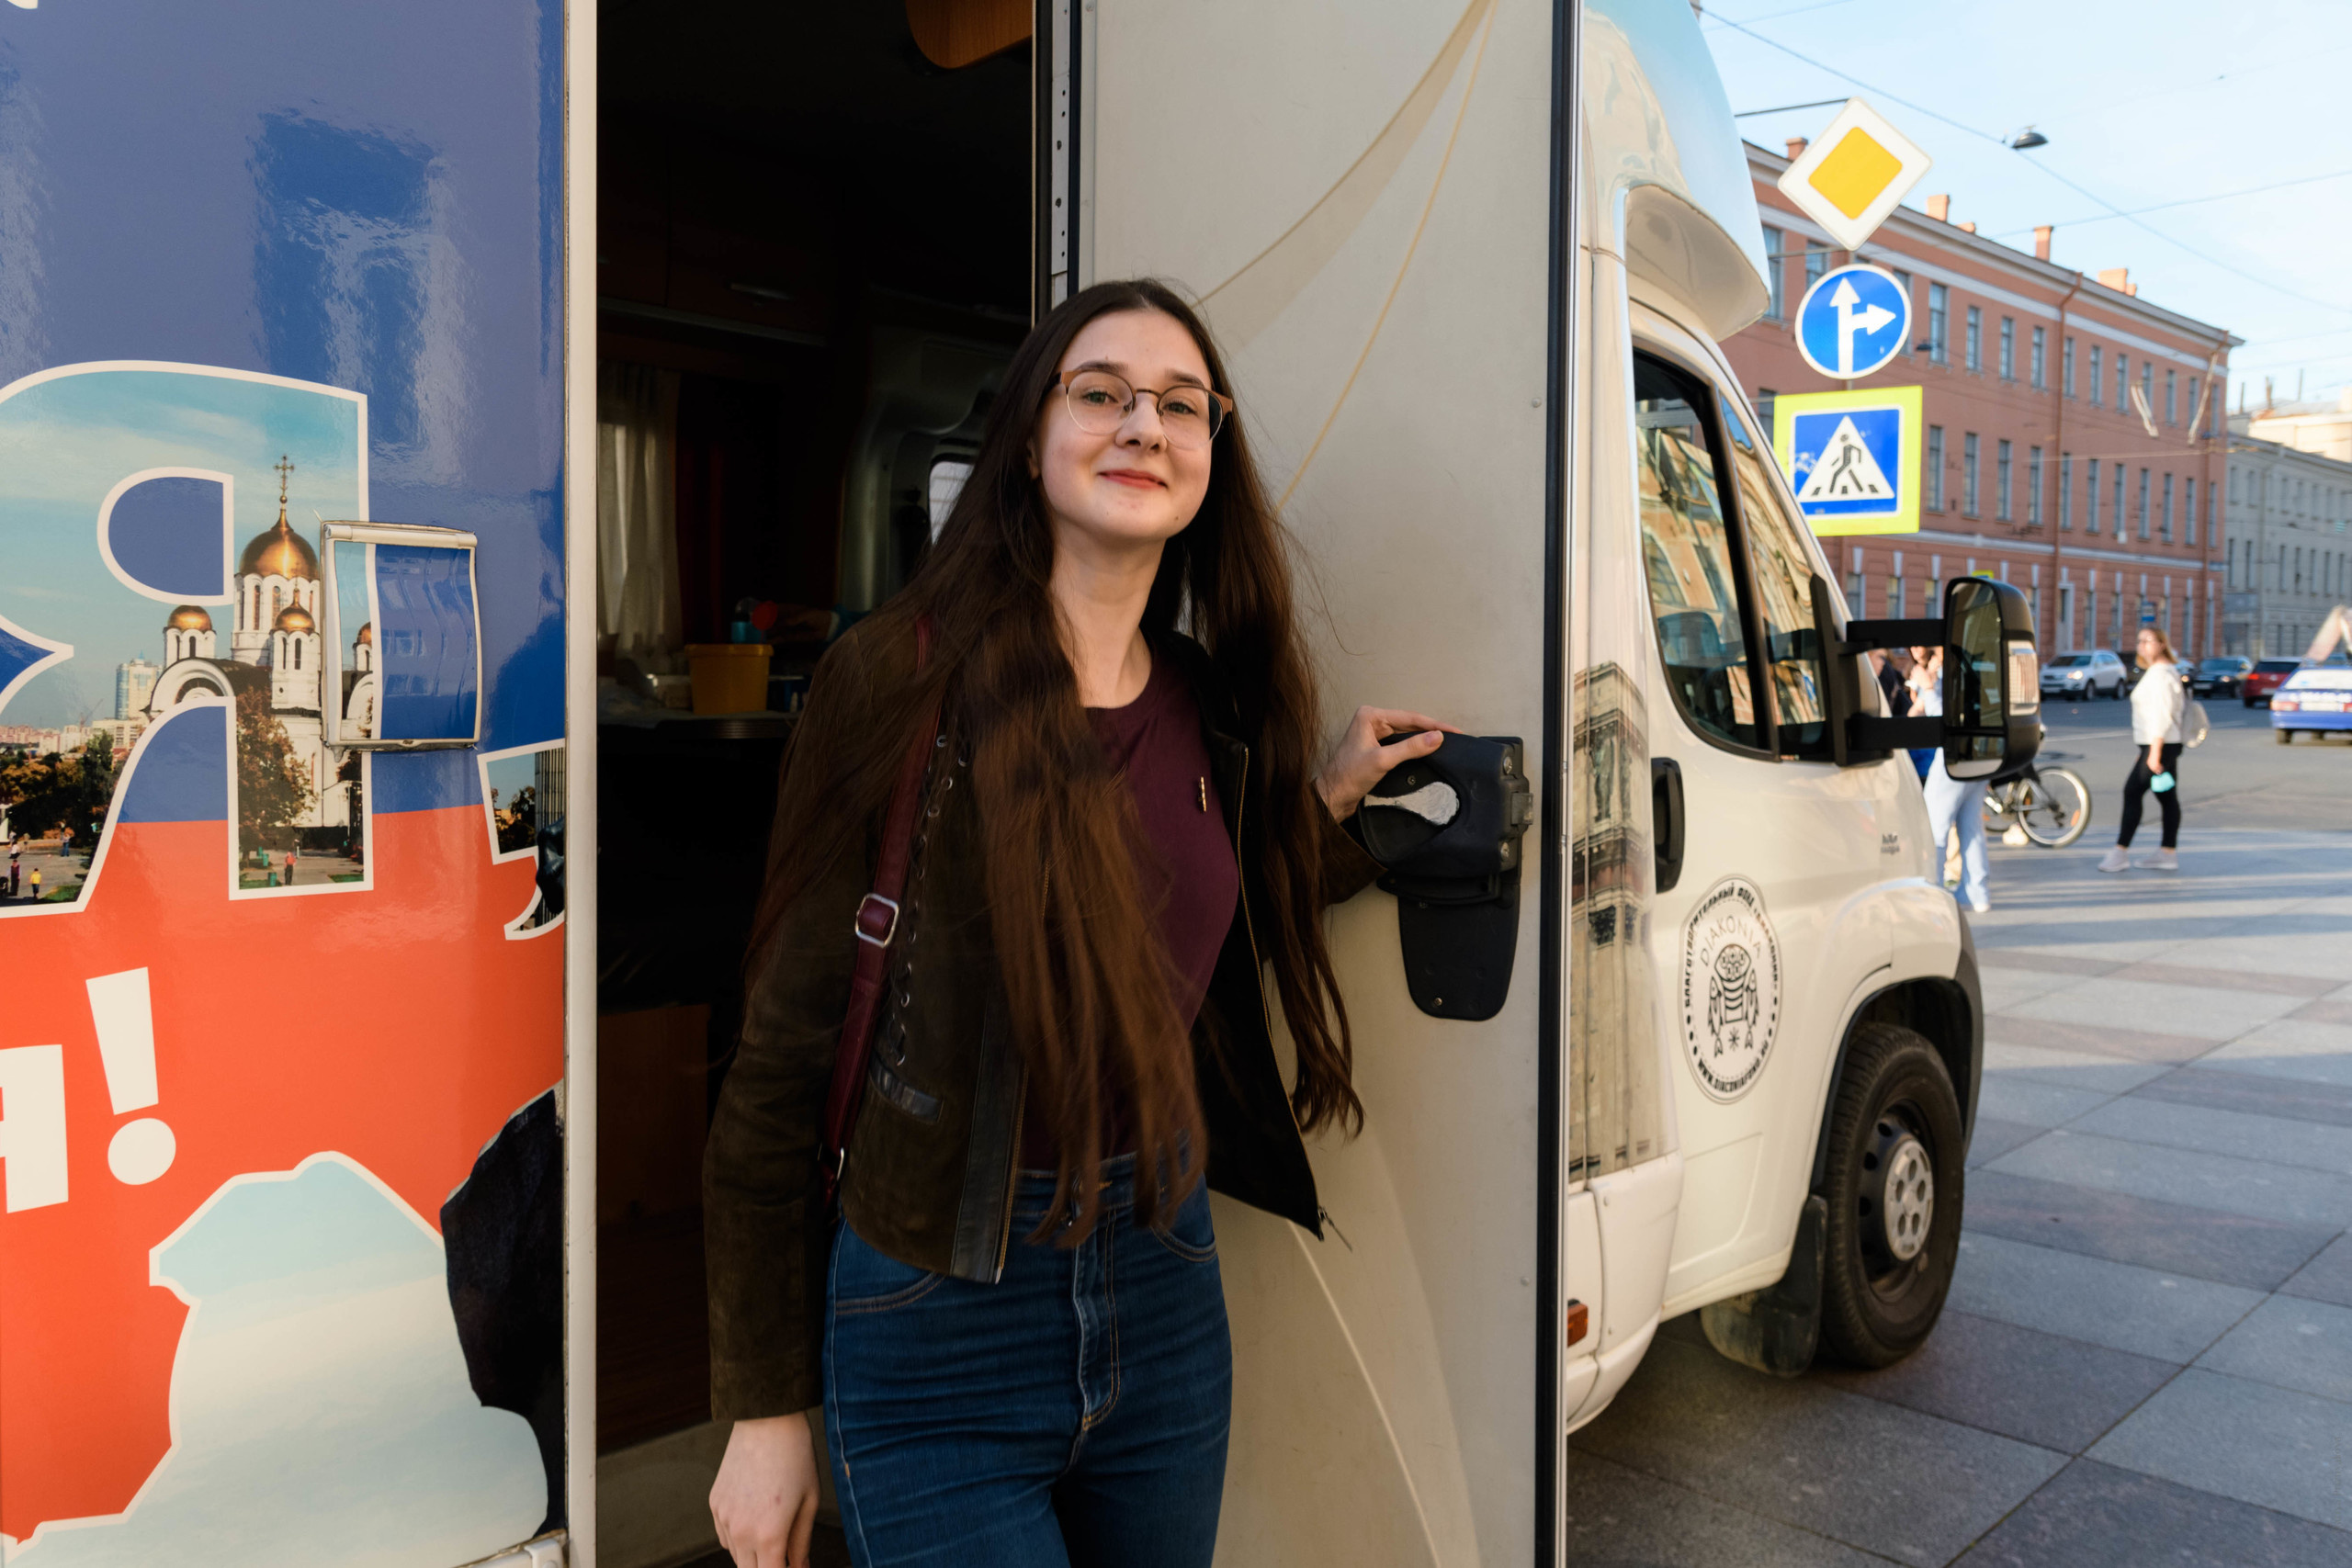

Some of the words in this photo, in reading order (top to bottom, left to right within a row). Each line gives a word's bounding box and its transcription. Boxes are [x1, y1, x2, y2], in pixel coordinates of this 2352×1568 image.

[1684, 882, 1735, 1009] БЛАГОТВОРИТЕЛЬНЫЙ
[1737, 886, 1755, 908] ФОНД
[1700, 915, 1761, 966] DIAKONIA
